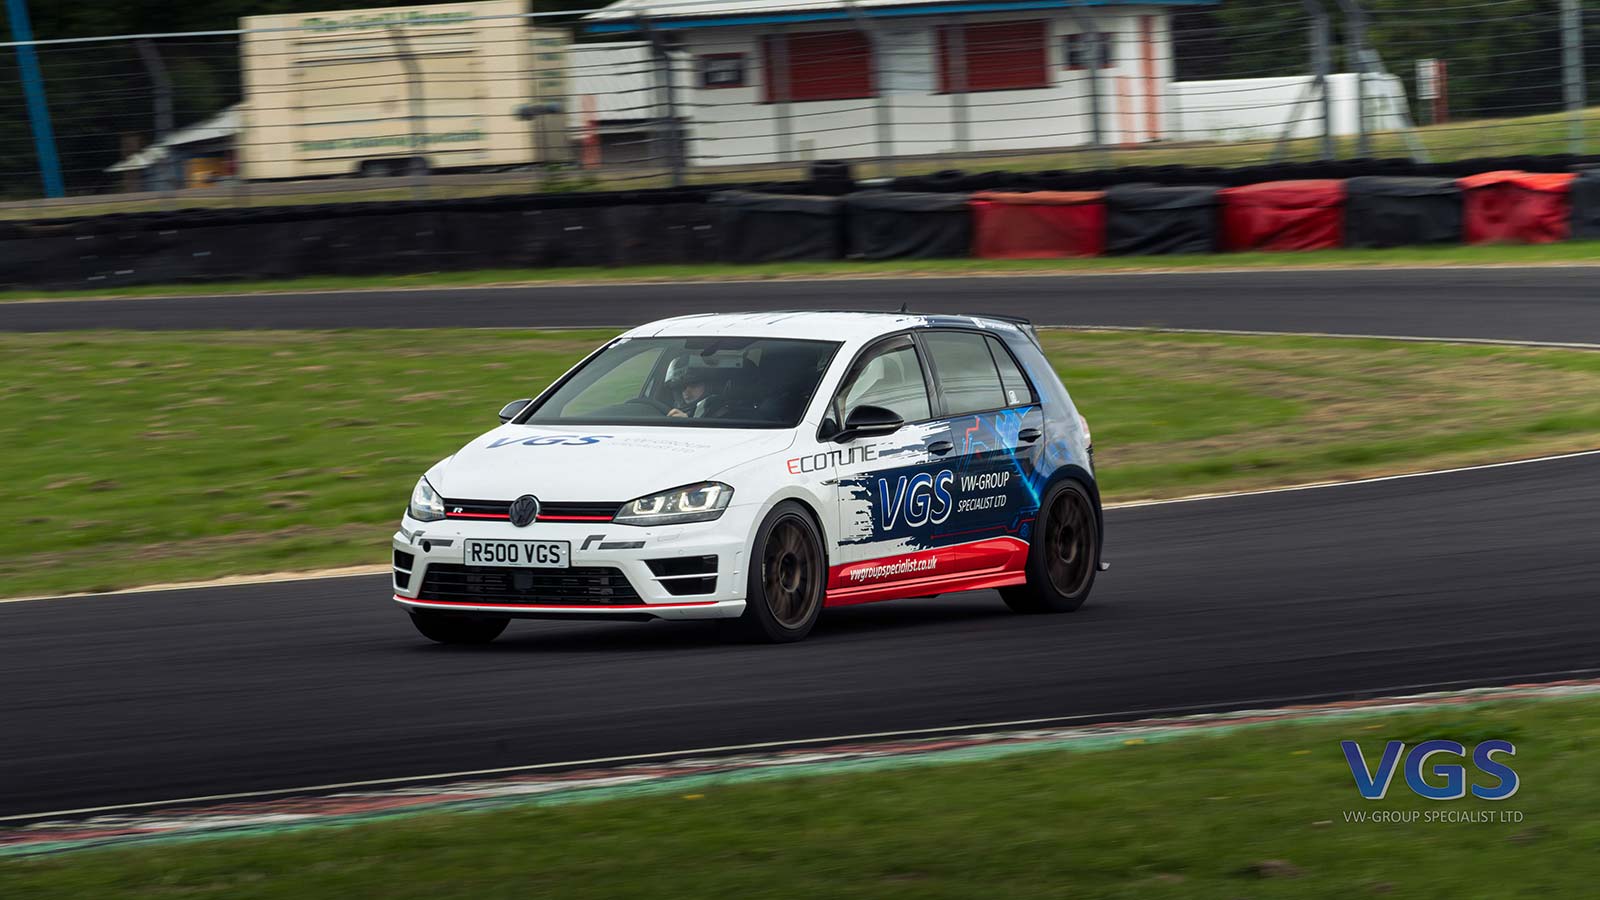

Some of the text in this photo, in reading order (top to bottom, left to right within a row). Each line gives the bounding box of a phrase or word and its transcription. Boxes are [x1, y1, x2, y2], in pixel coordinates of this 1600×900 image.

[486, 435, 614, 449] VGS
[787, 443, 877, 474] ECOTUNE
[961, 471, 1010, 492] VW-GROUP
[878, 469, 954, 531] VGS
[957, 494, 1007, 513] SPECIALIST LTD
[471, 542, 561, 564] R500 VGS
[849, 555, 938, 582] vwgroupspecialist.co.uk
